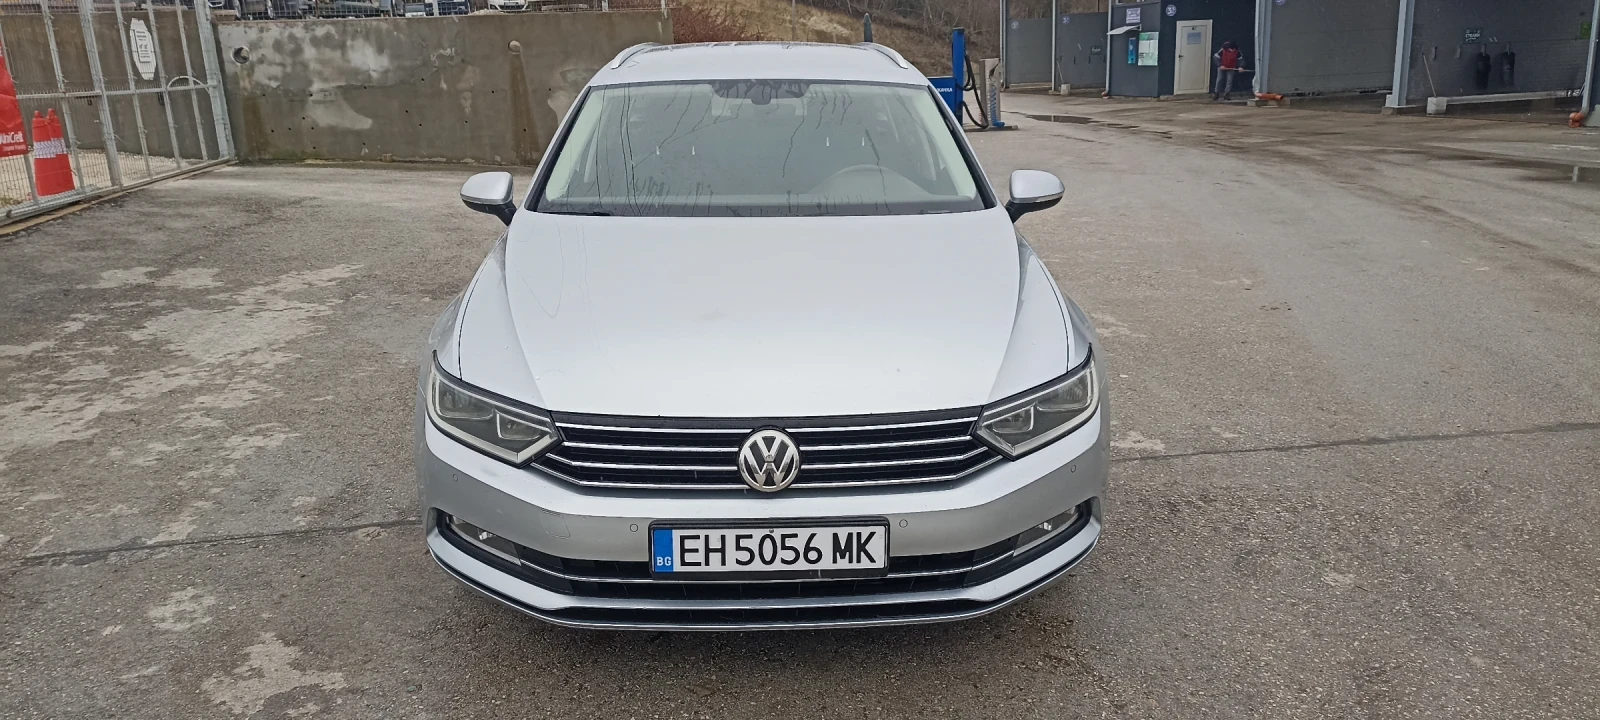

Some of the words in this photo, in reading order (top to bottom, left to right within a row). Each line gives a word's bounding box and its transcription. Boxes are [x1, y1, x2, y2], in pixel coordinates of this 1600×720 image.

[740, 430, 799, 492] VW
[656, 556, 672, 566] BG
[679, 534, 726, 567] EH
[735, 532, 823, 566] 5056
[832, 531, 877, 564] MK
